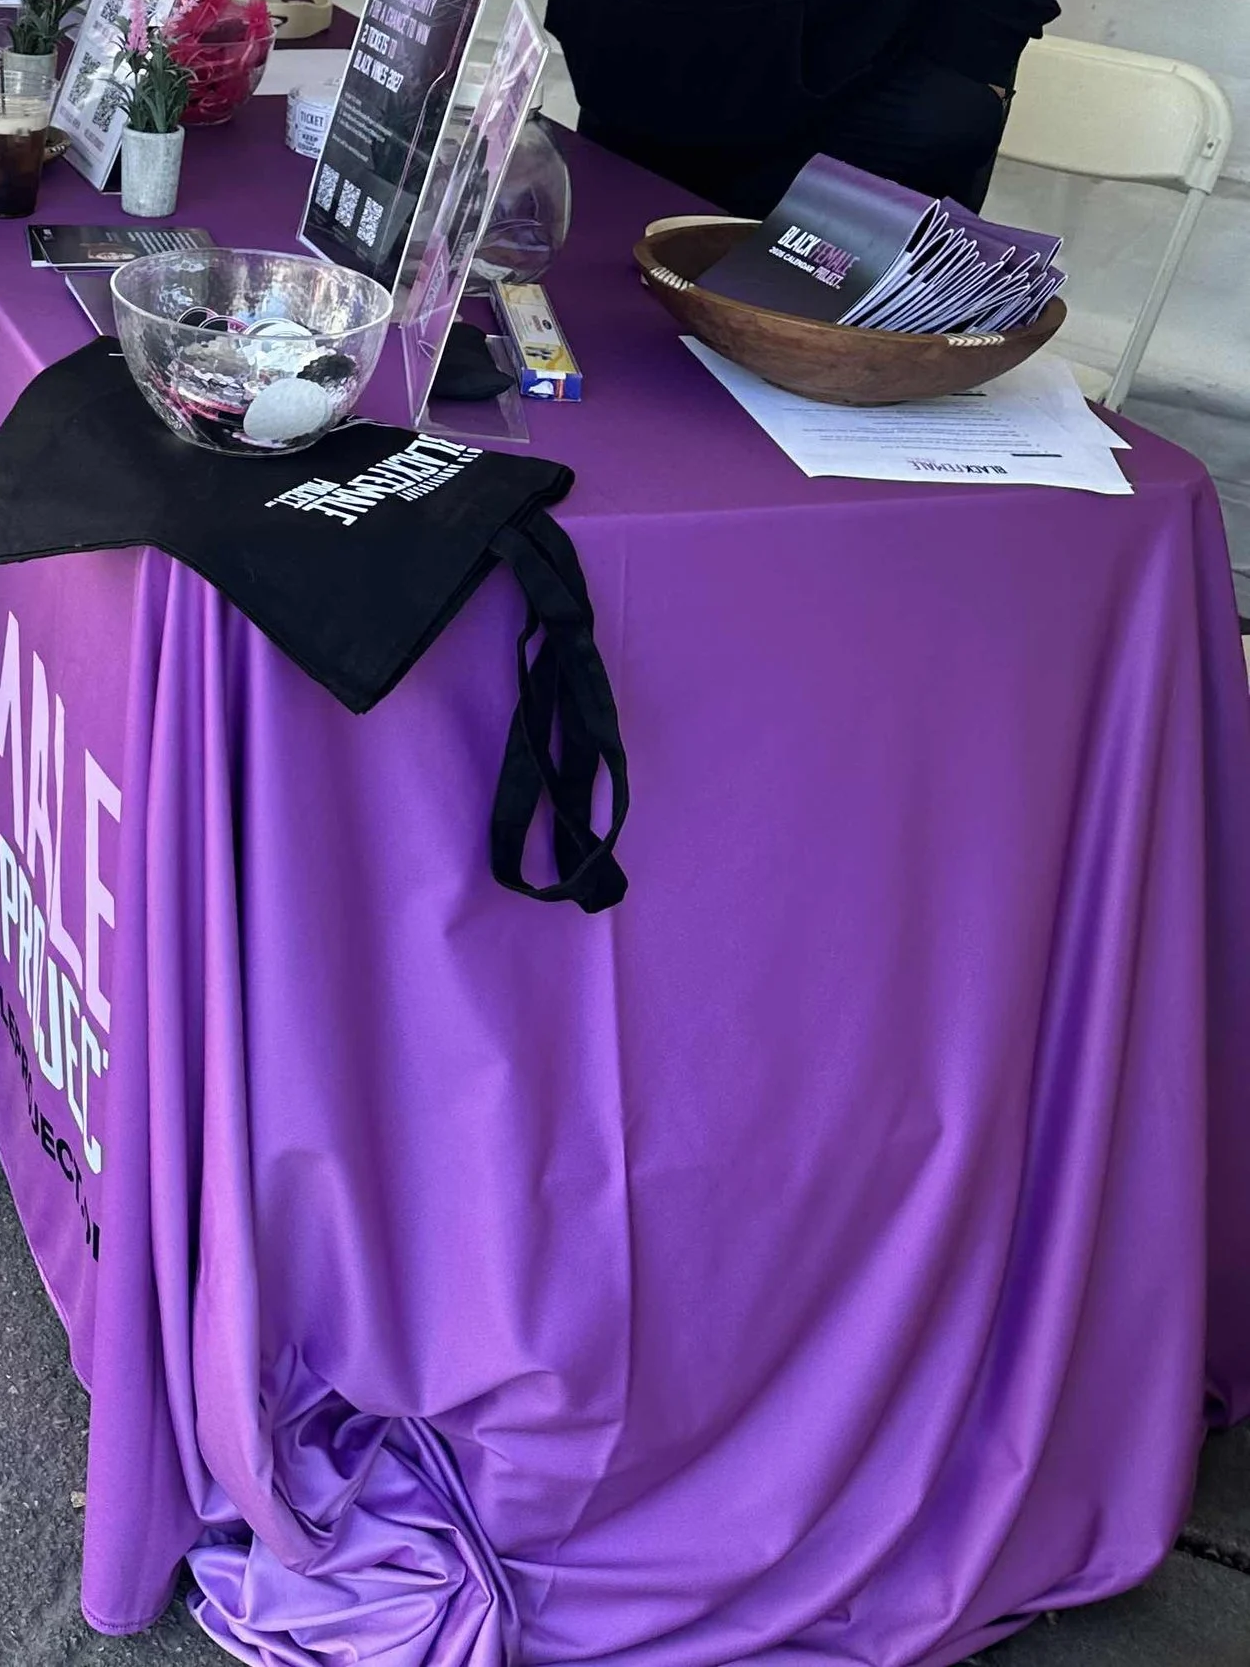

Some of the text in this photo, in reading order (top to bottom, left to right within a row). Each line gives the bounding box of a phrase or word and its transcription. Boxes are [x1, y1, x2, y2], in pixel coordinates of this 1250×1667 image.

[360, 24, 369, 44] 2
[365, 27, 390, 56] TICKETS
[353, 49, 373, 76] BLACK
[370, 61, 389, 86] VINES
[300, 110, 324, 127] TICKET
[783, 253, 815, 273] CALENDAR
